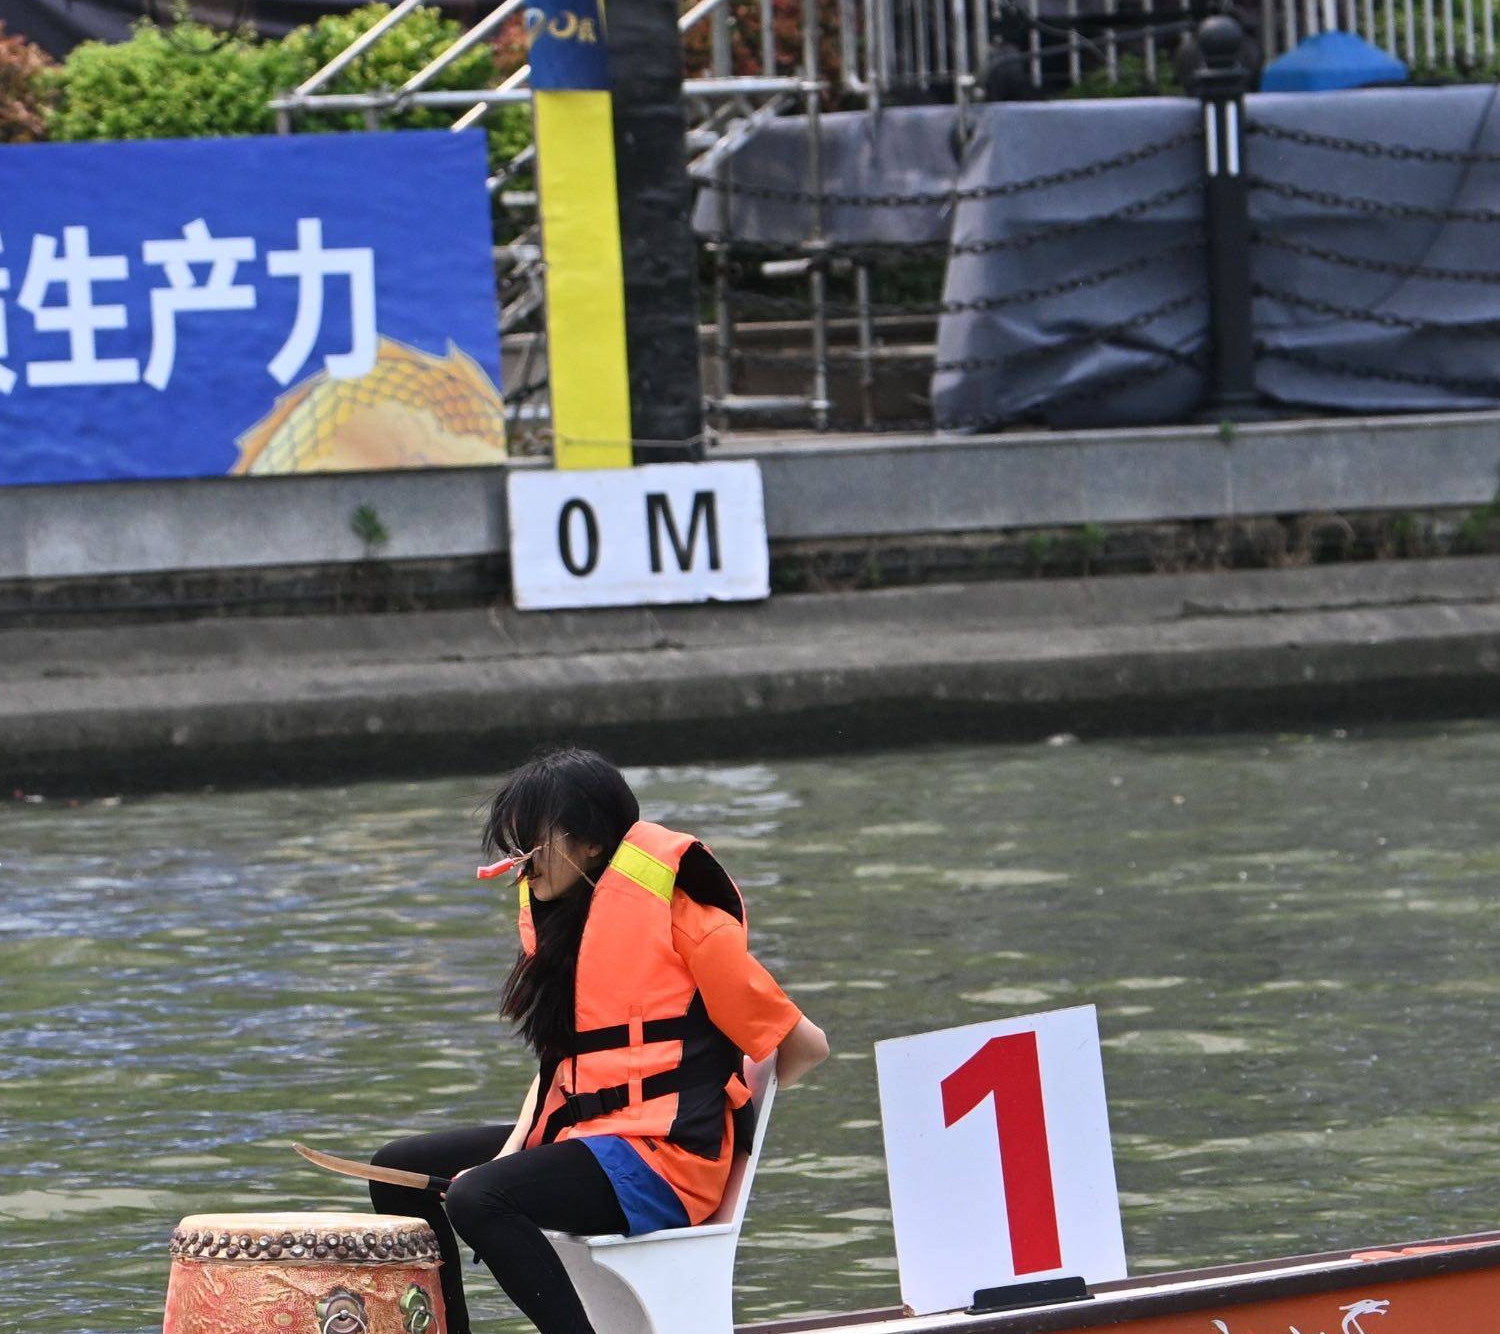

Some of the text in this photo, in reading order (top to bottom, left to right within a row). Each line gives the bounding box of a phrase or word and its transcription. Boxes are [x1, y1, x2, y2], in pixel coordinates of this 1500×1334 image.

[558, 490, 721, 577] 0 M
[940, 1030, 1063, 1276] 1
